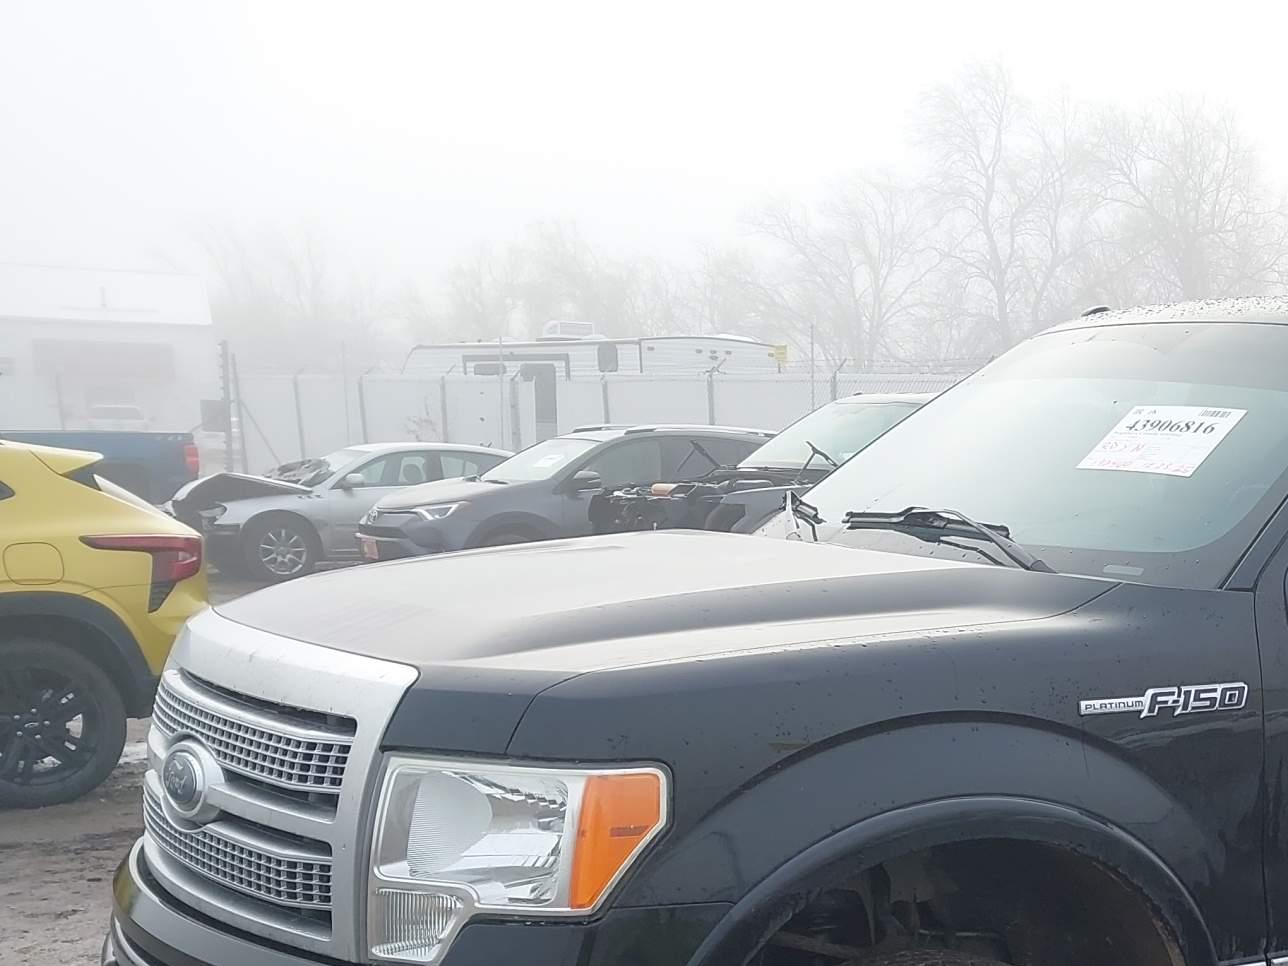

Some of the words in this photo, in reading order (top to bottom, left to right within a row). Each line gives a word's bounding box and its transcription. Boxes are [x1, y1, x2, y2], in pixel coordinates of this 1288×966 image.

[1125, 418, 1220, 435] 43906816
[1083, 699, 1145, 711] PLATINUM
[1139, 681, 1248, 719] F-150
